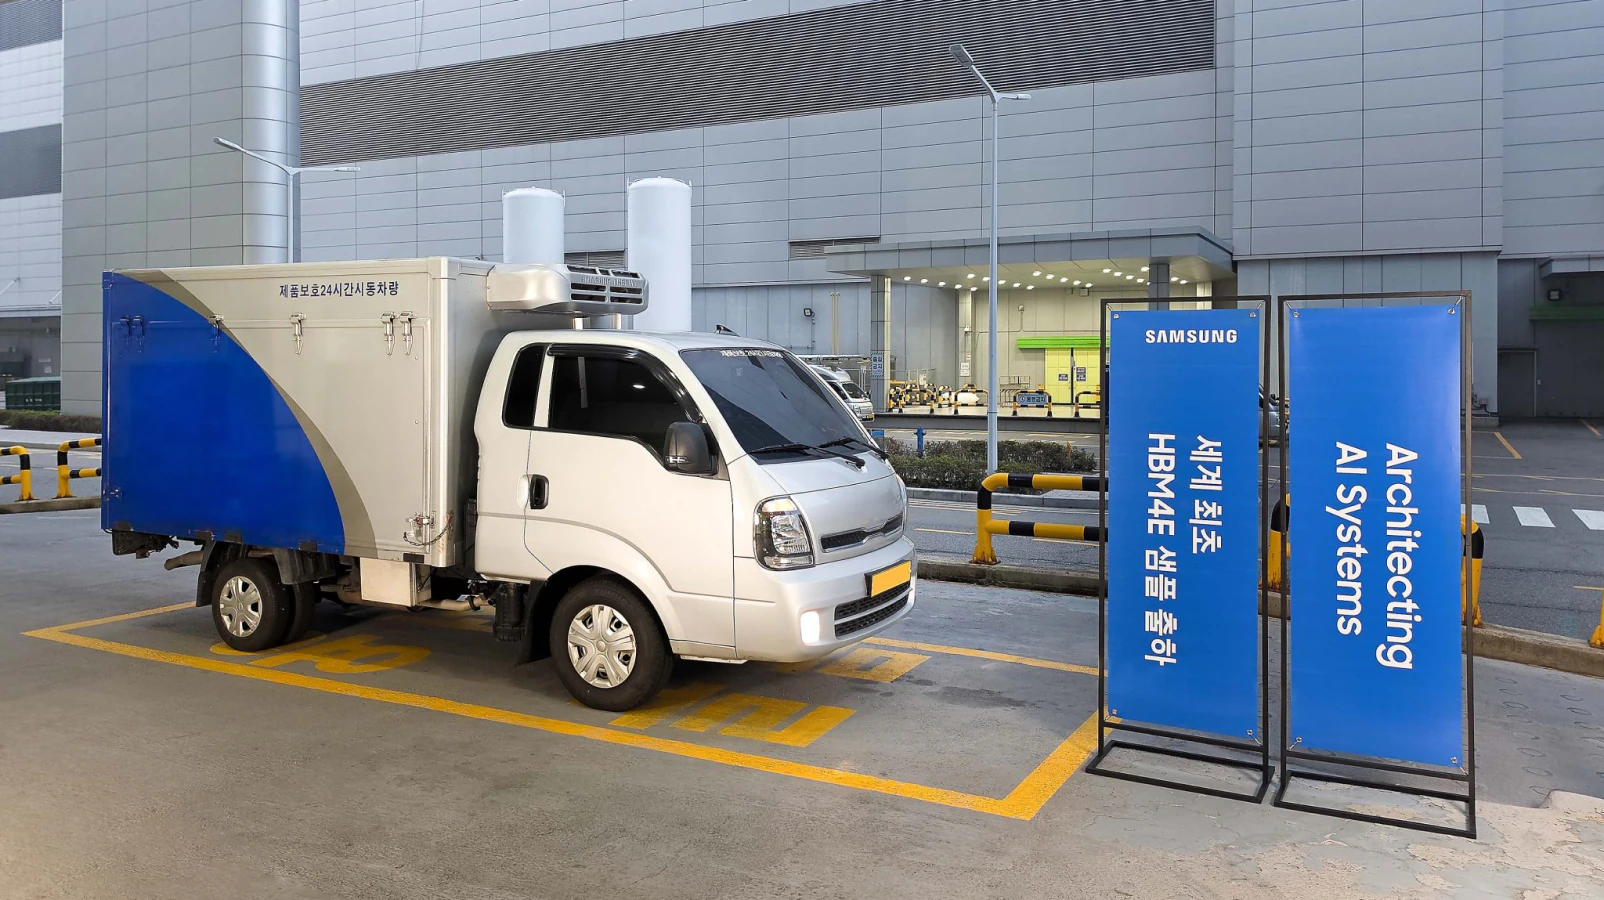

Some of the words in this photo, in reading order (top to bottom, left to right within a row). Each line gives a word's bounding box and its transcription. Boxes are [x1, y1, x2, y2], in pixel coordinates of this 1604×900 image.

[279, 280, 399, 299] 제품보호24시간시동차량
[1145, 329, 1238, 344] SAMSUNG
[1147, 433, 1176, 536] HBM4E
[1189, 434, 1223, 491] 세계
[1336, 441, 1368, 475] AI
[1189, 499, 1223, 554] 최초
[1144, 545, 1177, 602] 샘플
[1325, 484, 1369, 636] Systems
[1375, 442, 1422, 670] Architecting
[1144, 608, 1178, 667] 출하
